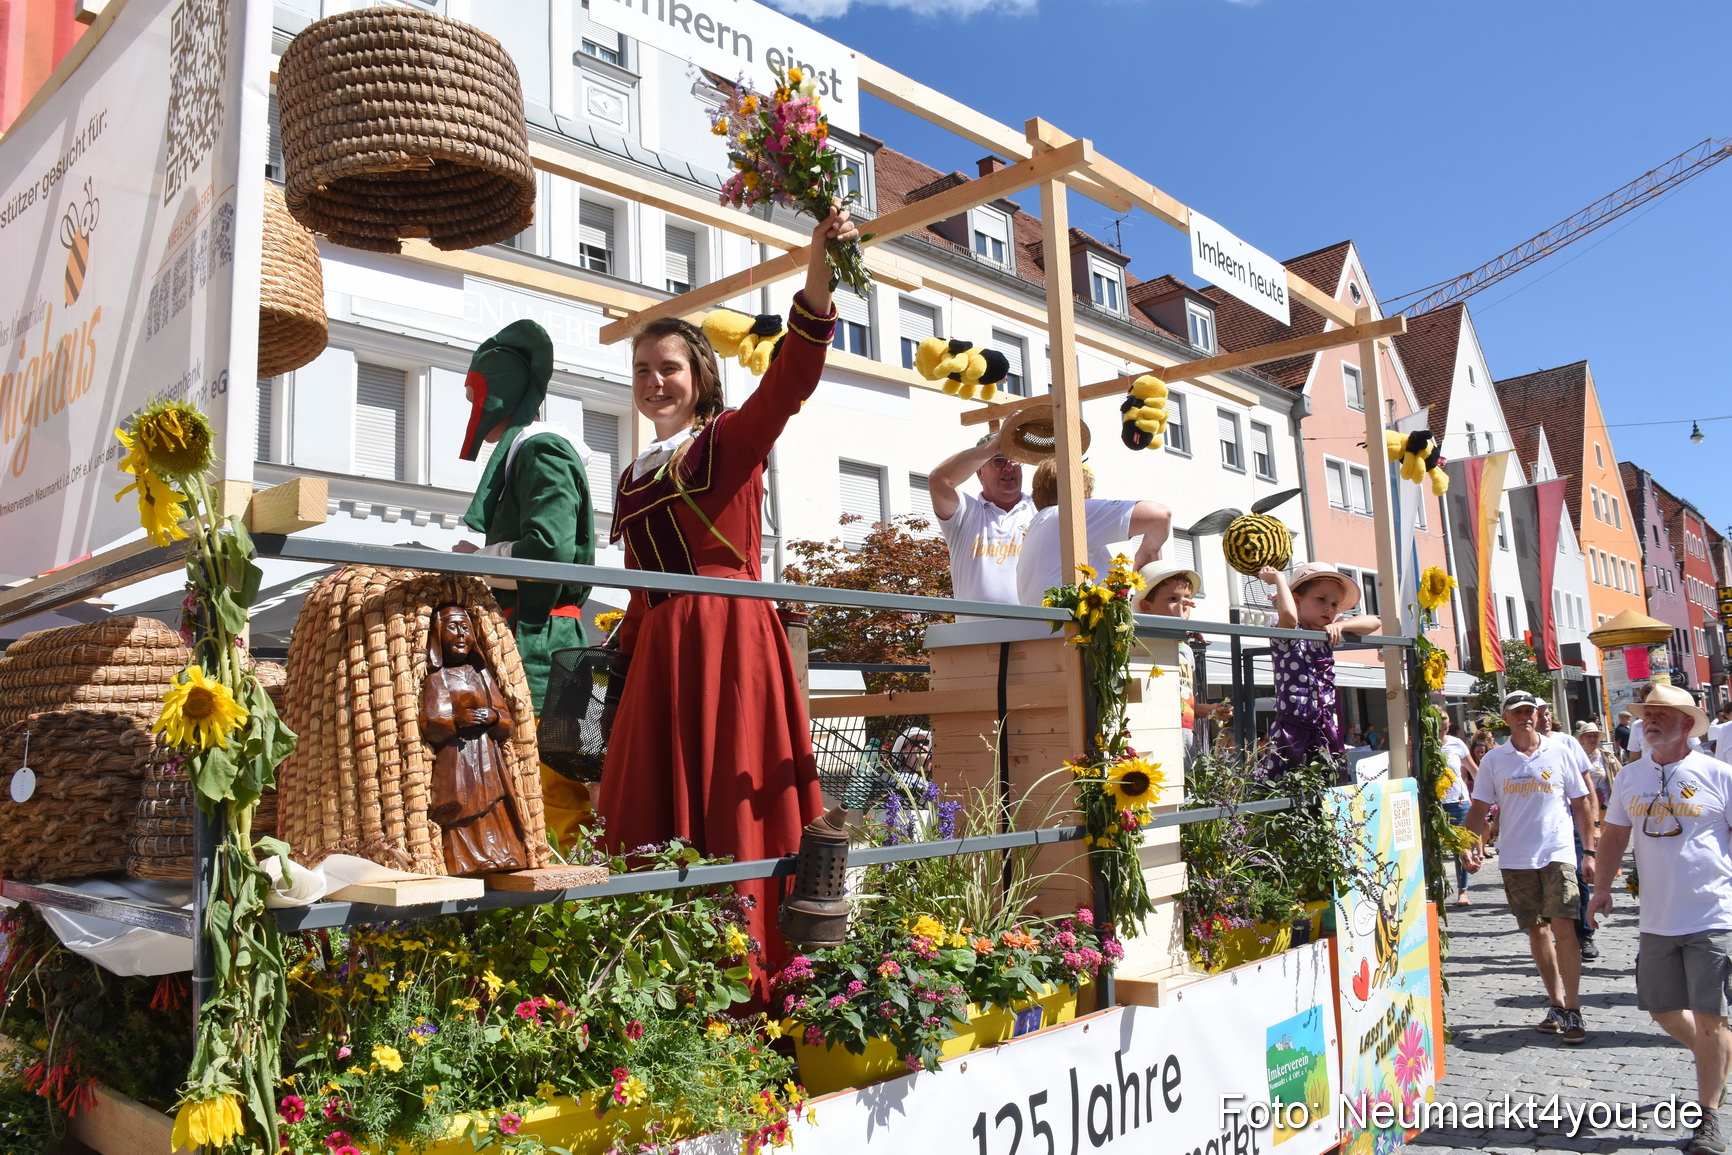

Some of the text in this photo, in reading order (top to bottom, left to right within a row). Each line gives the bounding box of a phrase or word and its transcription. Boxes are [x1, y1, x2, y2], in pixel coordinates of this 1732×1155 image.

[613, 0, 753, 63] kern
[42, 128, 86, 200] gesucht
[88, 108, 107, 146] für:
[1197, 230, 1284, 305] Imkern heute
[211, 369, 228, 400] eG
[35, 476, 62, 502] Neumarkt
[1503, 776, 1556, 798] Honighaus
[1360, 1001, 1396, 1055] LASST ES
[1267, 1053, 1309, 1082] Imkerverein
[973, 1049, 1182, 1155] 125 Jahre
